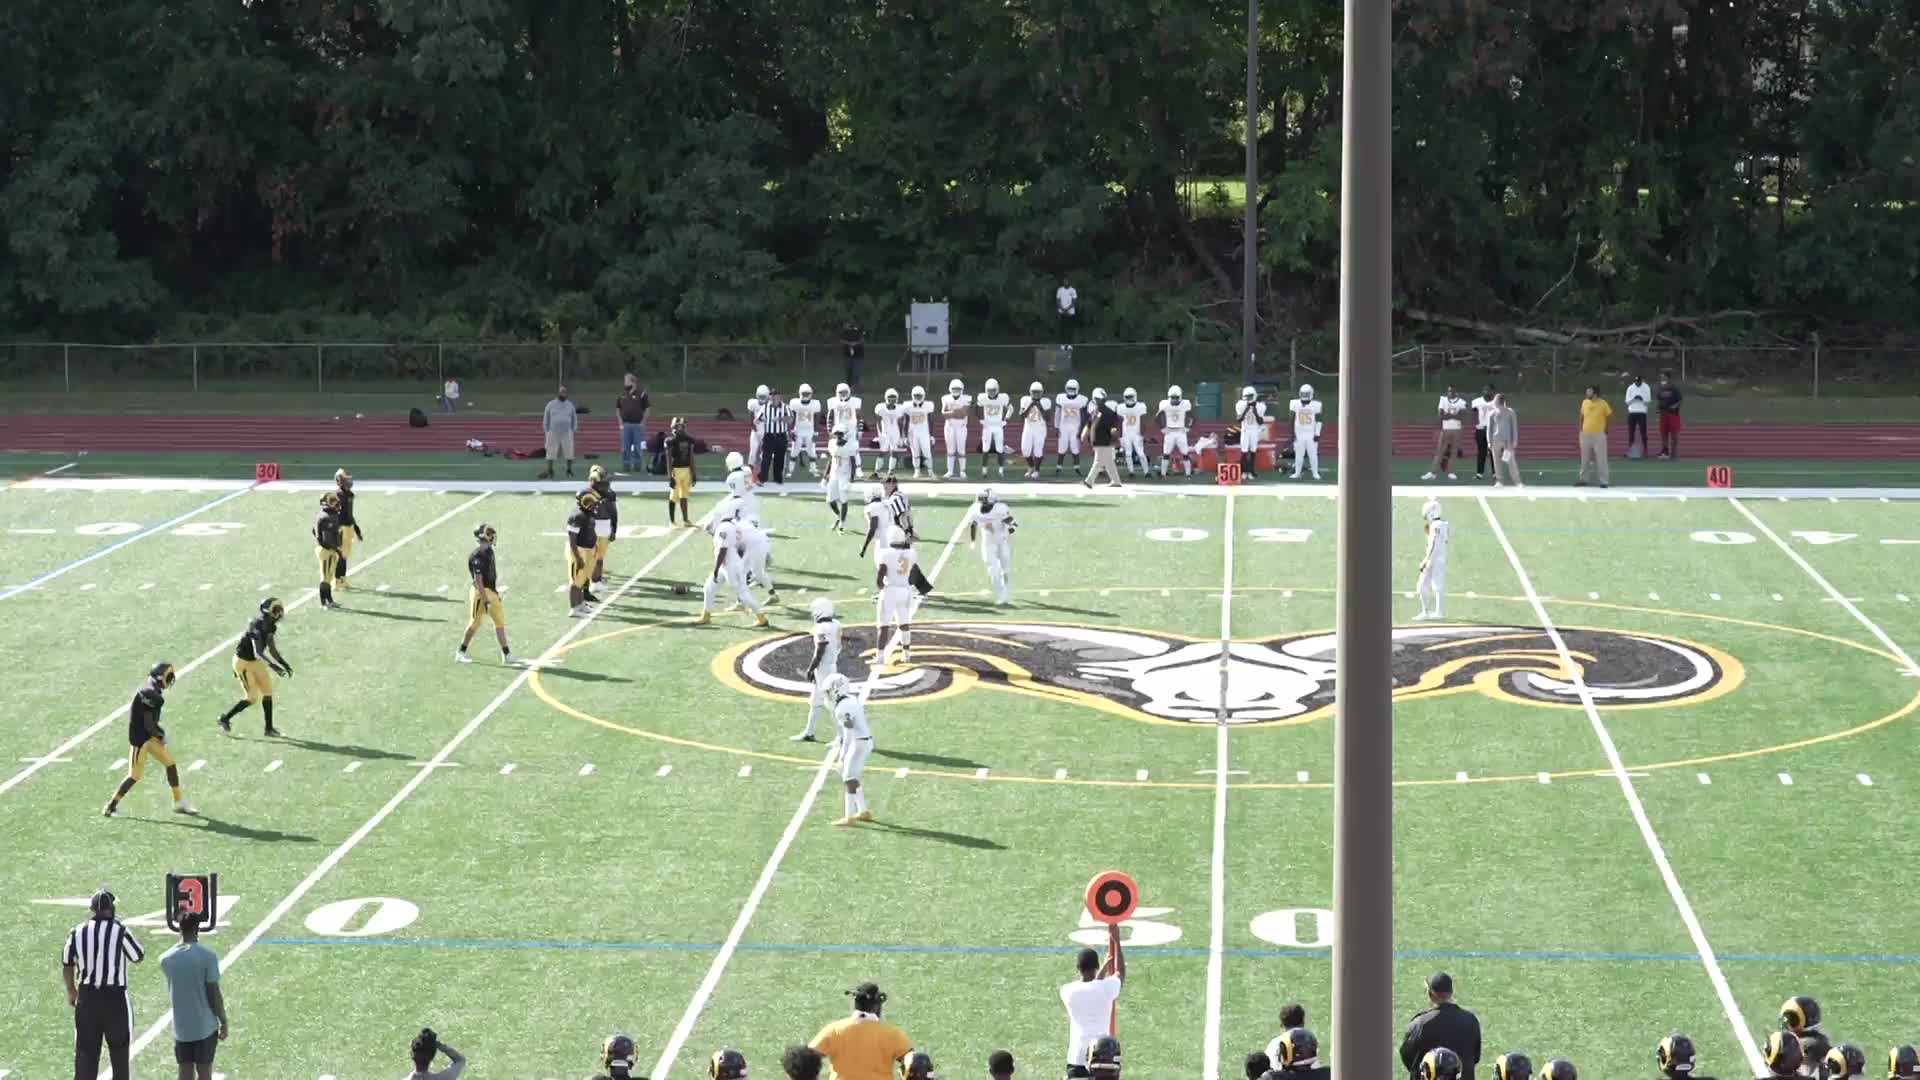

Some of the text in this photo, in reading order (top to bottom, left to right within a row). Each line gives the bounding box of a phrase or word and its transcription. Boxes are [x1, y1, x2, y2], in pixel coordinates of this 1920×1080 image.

[257, 464, 276, 478] 30
[1220, 465, 1239, 481] 50
[1709, 467, 1728, 485] 40
[178, 879, 203, 913] 3
